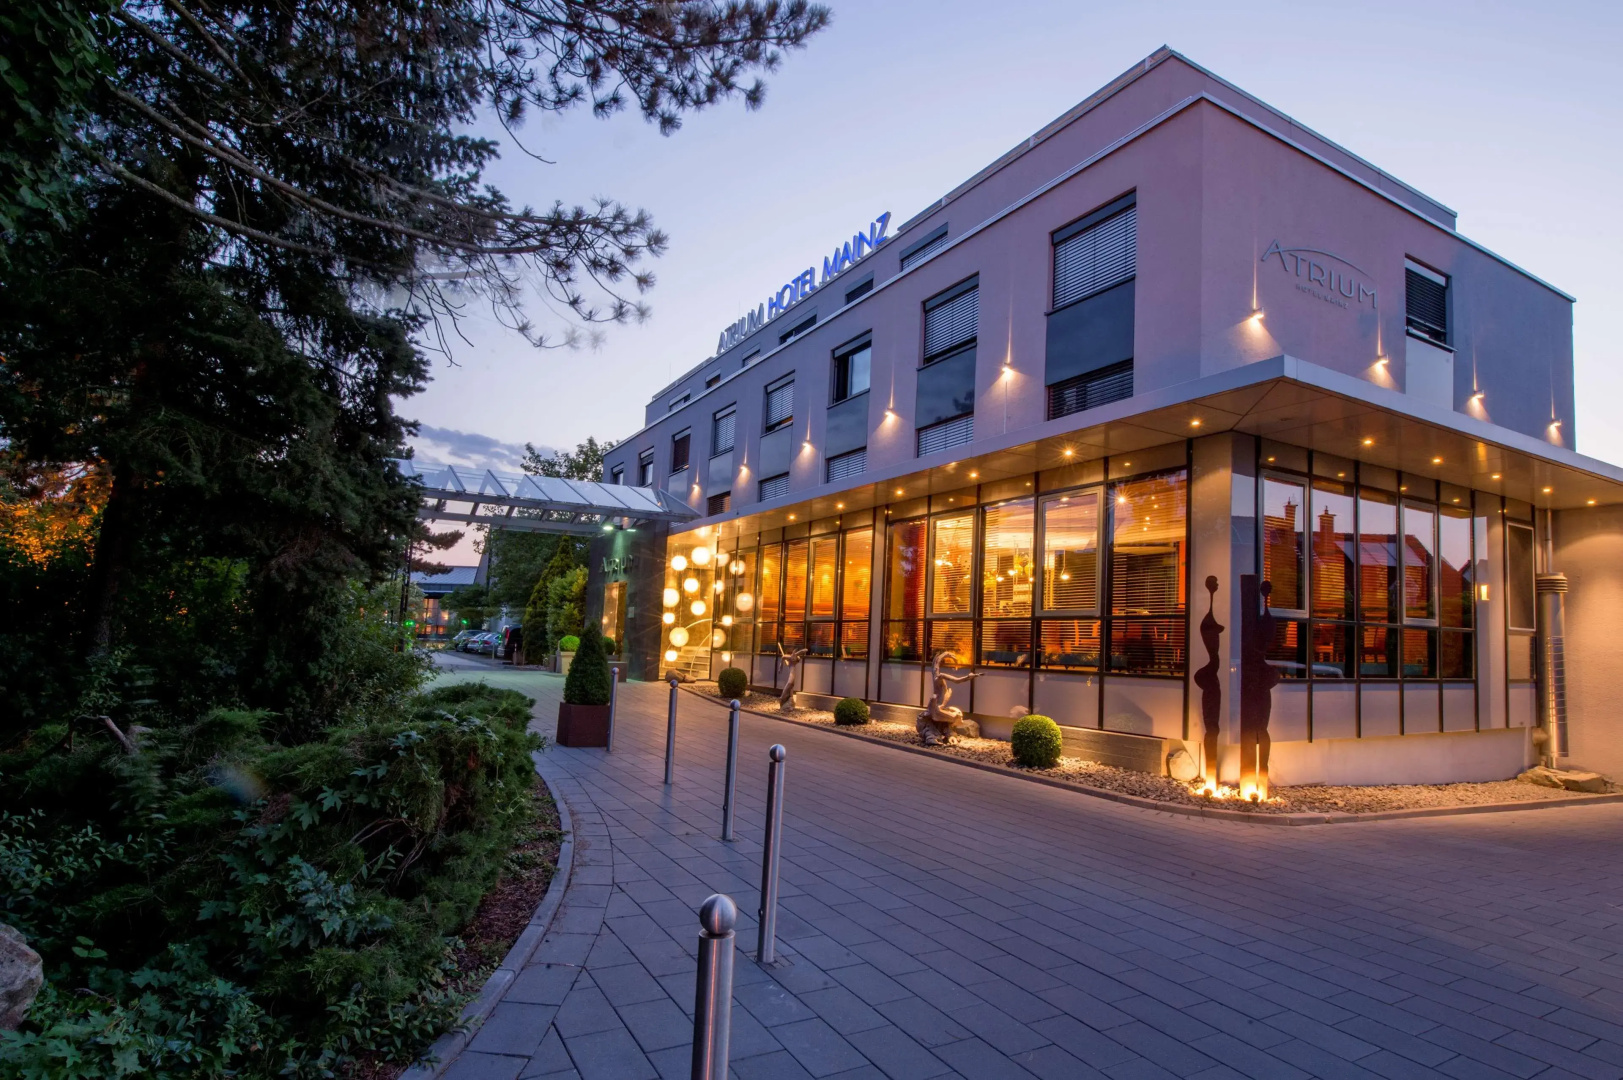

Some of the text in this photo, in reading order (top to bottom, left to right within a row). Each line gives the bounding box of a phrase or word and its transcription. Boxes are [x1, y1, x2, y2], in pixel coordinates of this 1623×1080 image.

[716, 211, 891, 354] ATRIUM HOTEL MAINZ
[1260, 239, 1377, 309] ATRIUM
